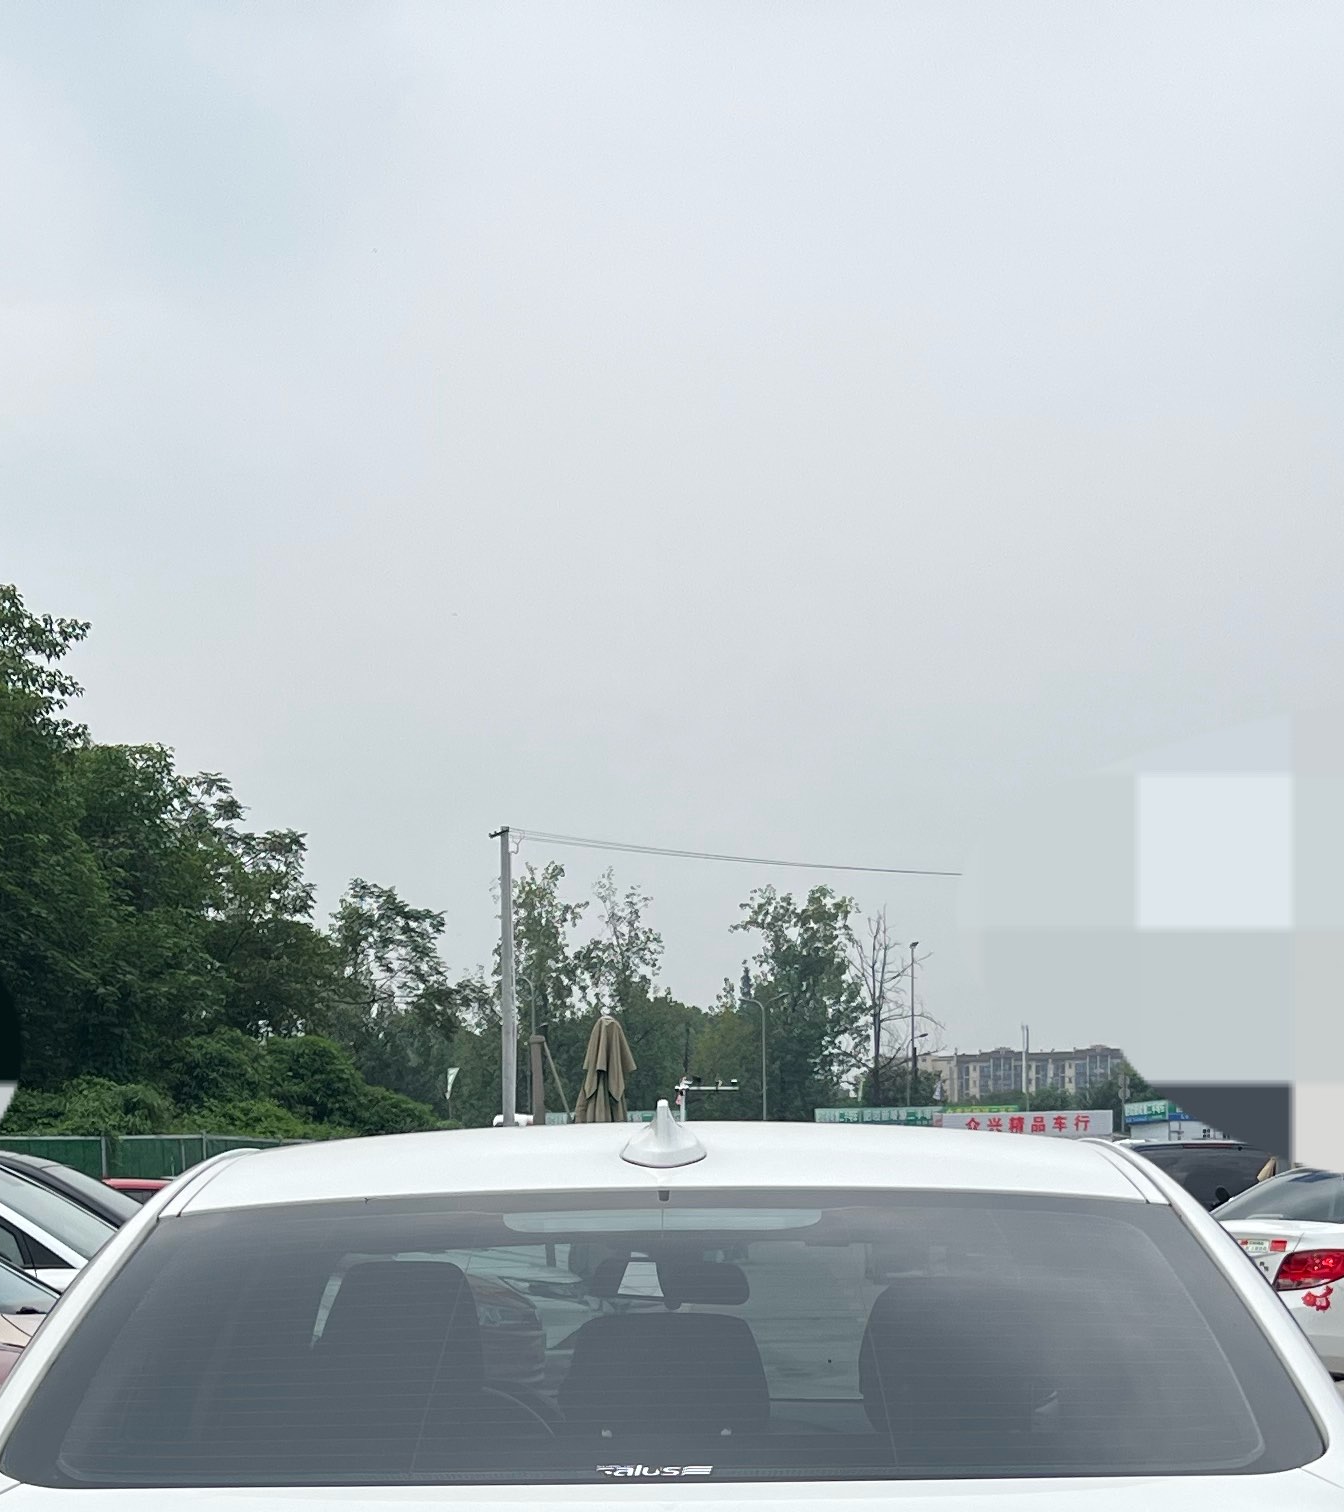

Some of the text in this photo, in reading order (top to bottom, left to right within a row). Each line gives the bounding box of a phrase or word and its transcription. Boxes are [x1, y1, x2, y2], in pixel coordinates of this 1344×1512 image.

[965, 1114, 1090, 1134] 众兴精品车行
